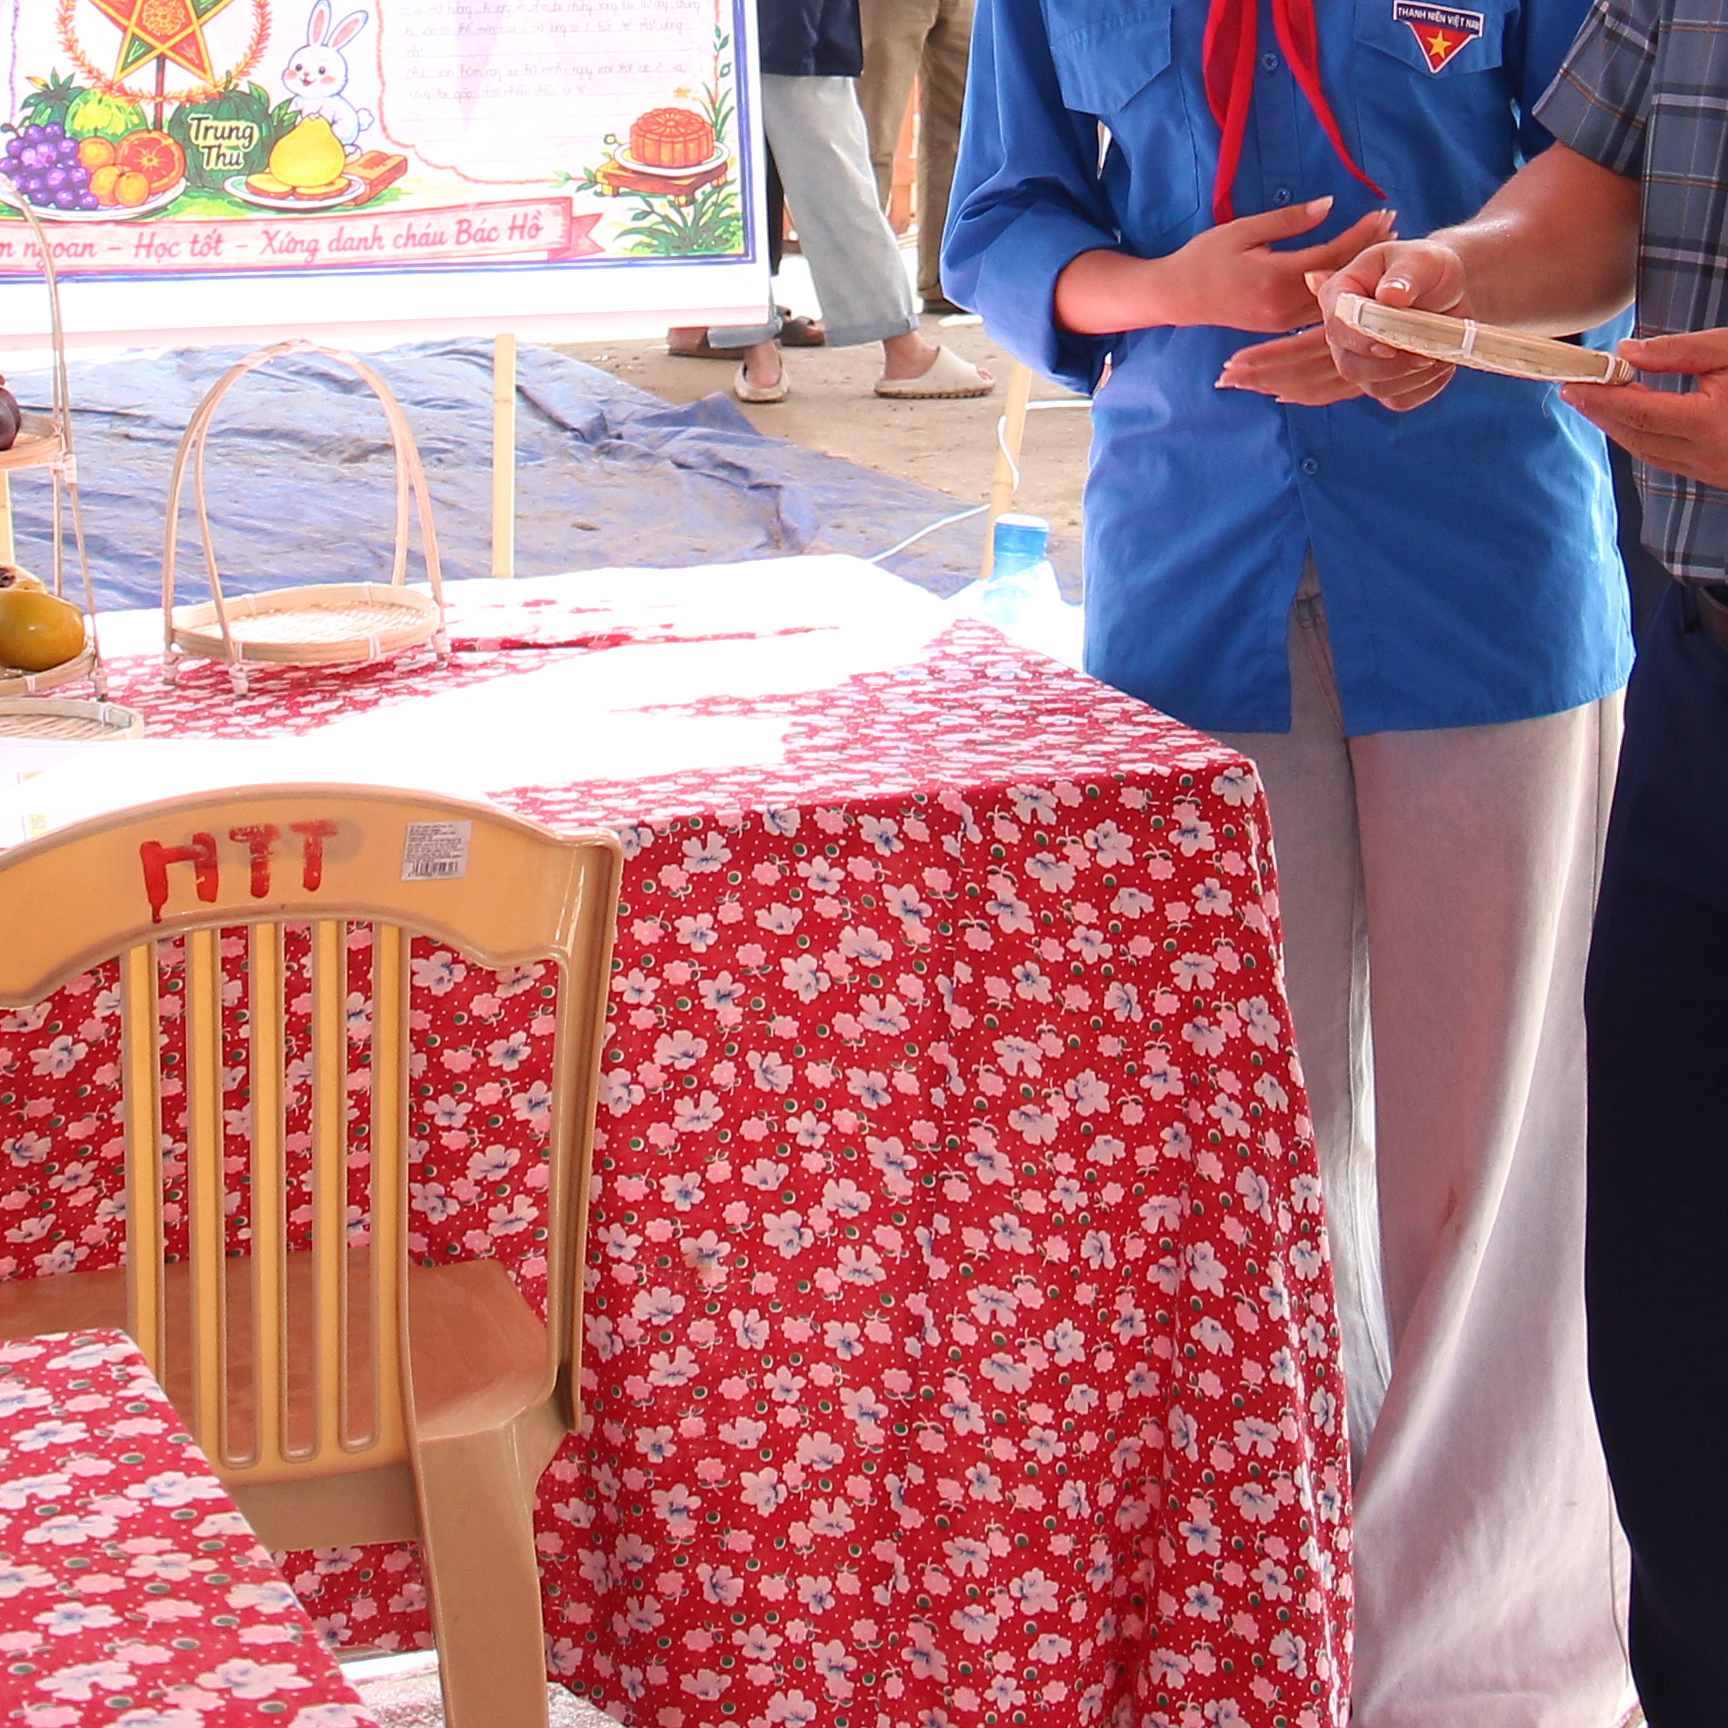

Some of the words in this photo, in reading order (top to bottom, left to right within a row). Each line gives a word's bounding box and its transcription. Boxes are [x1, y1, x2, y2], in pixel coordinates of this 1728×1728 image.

[1398, 7, 1426, 19] THANH
[1427, 11, 1446, 24] NIÊN
[1447, 14, 1464, 28] VIỆT
[191, 116, 255, 151] Trung
[201, 144, 243, 170] Thu
[134, 234, 180, 261] Học
[189, 227, 225, 258] tốt
[260, 229, 320, 264] Xứng
[328, 224, 385, 253] danh
[393, 217, 448, 250] cháu
[455, 217, 499, 247] Bác
[507, 211, 544, 241] Hồ
